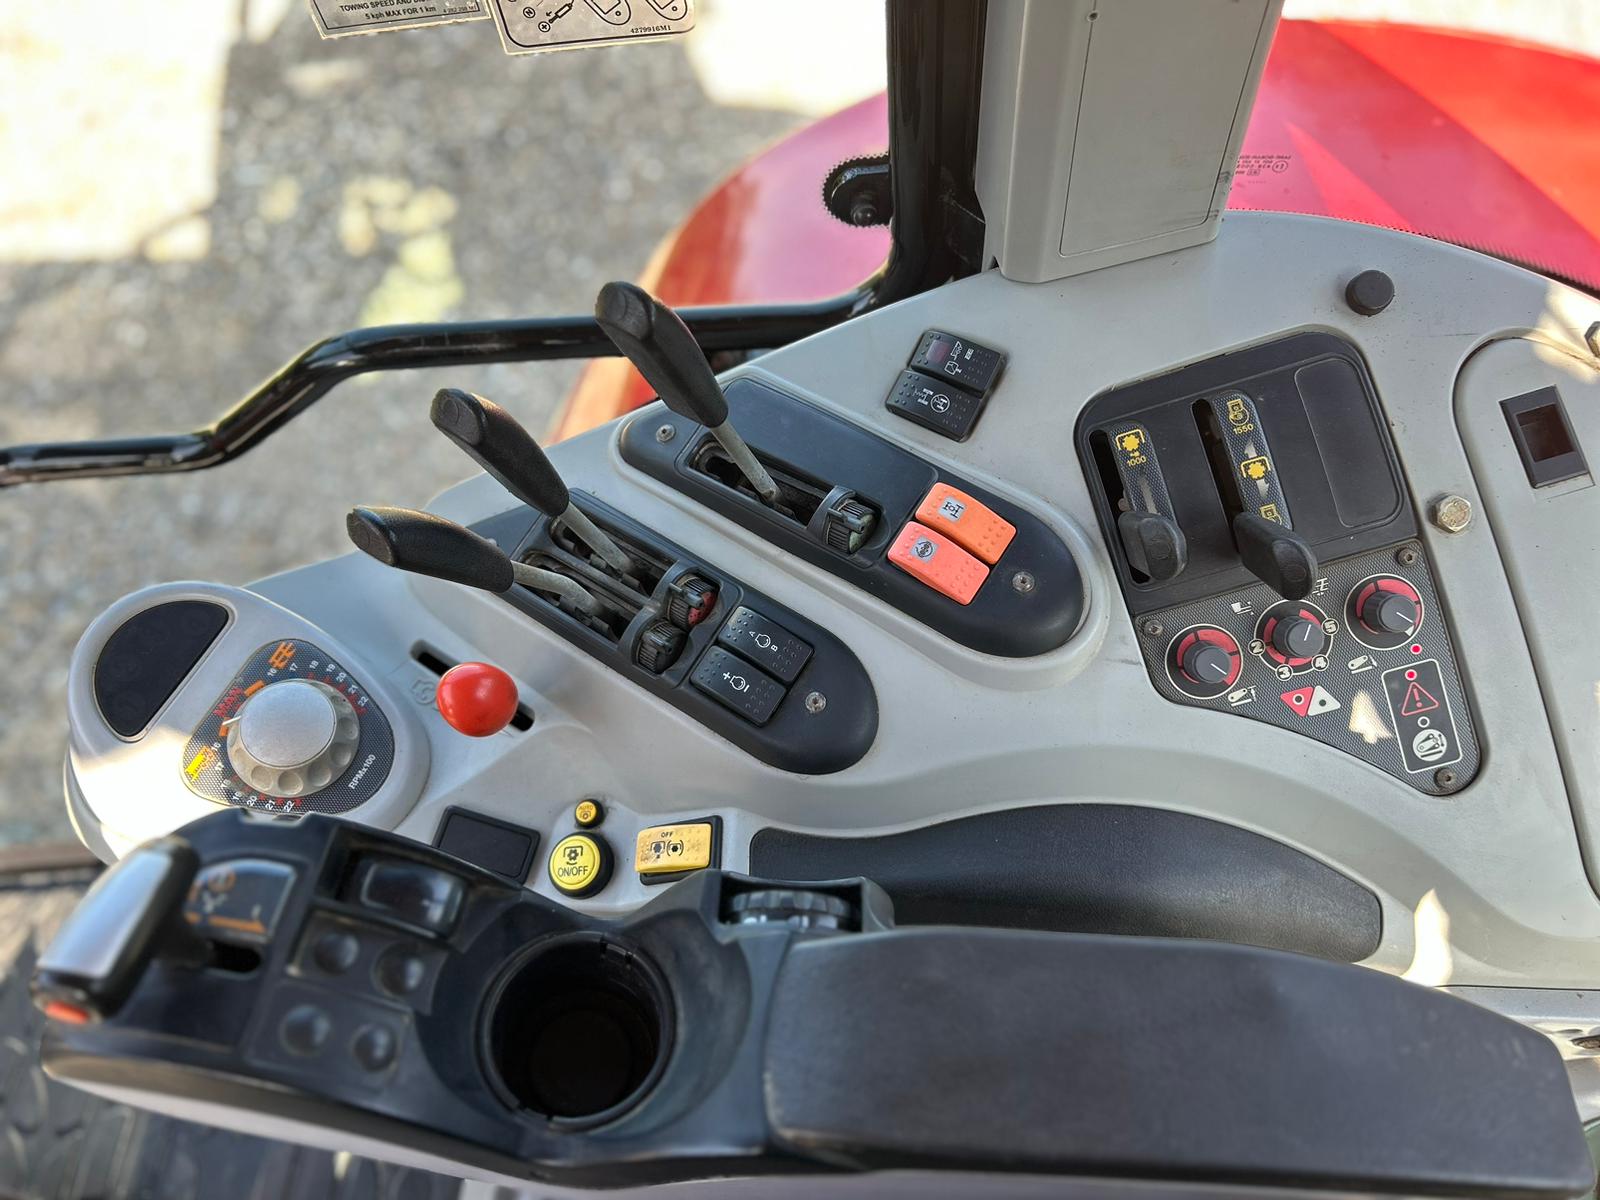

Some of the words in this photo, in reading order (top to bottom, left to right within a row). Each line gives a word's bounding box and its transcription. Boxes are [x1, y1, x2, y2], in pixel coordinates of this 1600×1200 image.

[340, 3, 369, 12] TOWING
[369, 0, 395, 9] SPEED
[370, 12, 385, 20] kph
[630, 25, 672, 34] 4279916M1
[1233, 423, 1254, 435] 1550
[1126, 455, 1147, 467] 1000
[1324, 620, 1337, 633] 5
[1250, 640, 1263, 654] 2
[289, 662, 298, 671] 17
[309, 660, 319, 669] 18
[326, 663, 336, 673] 19
[1315, 656, 1327, 669] 4
[267, 668, 277, 677] 16
[336, 672, 347, 682] 20
[1278, 666, 1291, 679] 3
[348, 684, 359, 694] 21
[357, 696, 369, 707] 22
[211, 742, 221, 751] 16
[214, 761, 224, 771] 17
[348, 754, 376, 790] RPMx100
[246, 795, 258, 807] 20
[265, 799, 275, 810] 21
[283, 800, 295, 812] 22
[557, 865, 589, 877] ON/OFF
